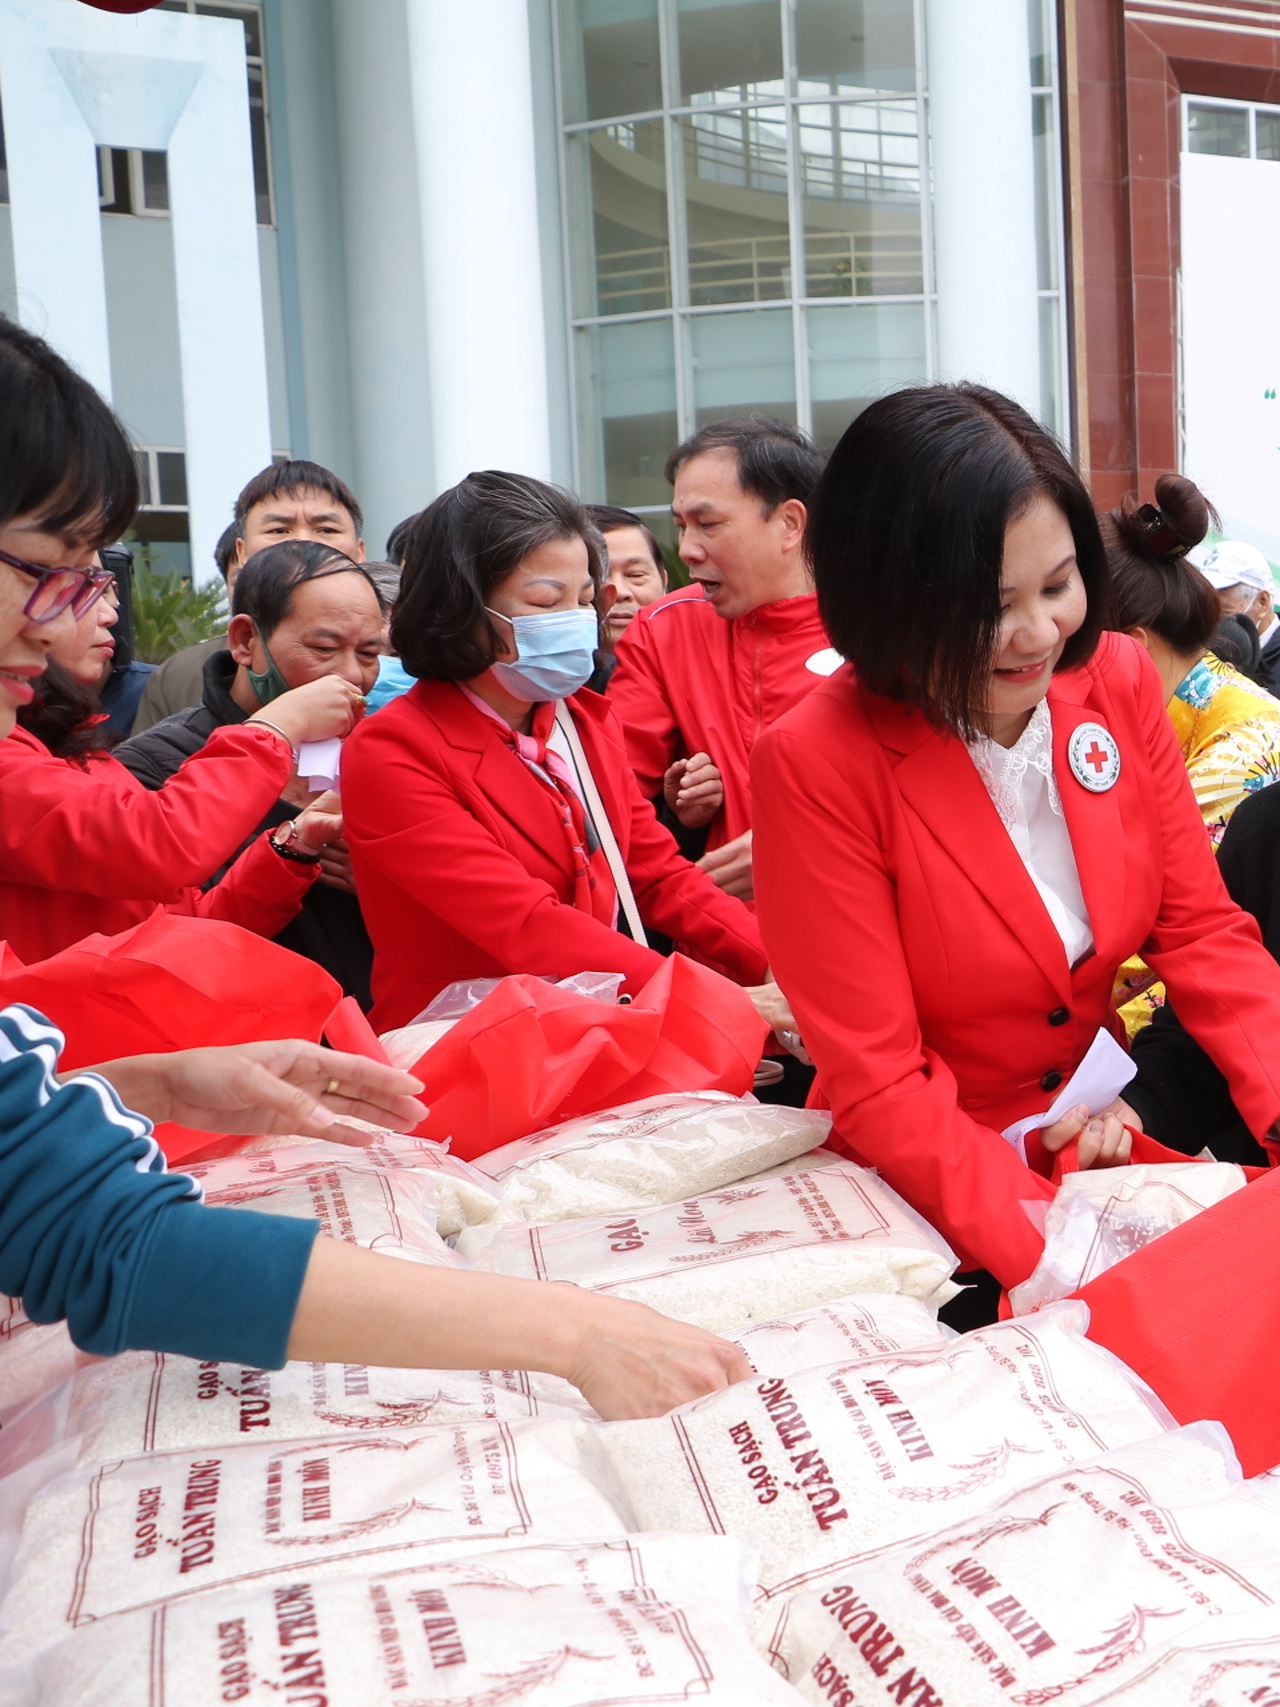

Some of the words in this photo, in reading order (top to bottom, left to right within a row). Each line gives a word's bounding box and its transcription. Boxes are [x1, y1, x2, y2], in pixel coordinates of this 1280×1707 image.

[197, 1371, 224, 1400] GẠO
[344, 1365, 370, 1396] KIN
[862, 1379, 904, 1407] MÔN
[1028, 1363, 1046, 1389] 888
[225, 1370, 271, 1432] TUẤN
[757, 1378, 812, 1450] TRUNG
[728, 1420, 763, 1465] SẠCH
[885, 1409, 935, 1462] KINH
[183, 1459, 223, 1511] TRUNG
[295, 1457, 330, 1482] MÔN
[747, 1464, 779, 1505] GẠO
[783, 1449, 848, 1531] TUẤN
[136, 1485, 166, 1522] SẠCH
[302, 1485, 331, 1522] KINH
[1119, 1490, 1146, 1507] 102
[134, 1523, 163, 1559] GẠO
[165, 1510, 216, 1574] TUẤN
[1139, 1509, 1167, 1535] 888
[946, 1557, 1002, 1598] MÔN
[273, 1584, 319, 1647] TRUNG
[821, 1585, 905, 1677] TRUNG
[986, 1594, 1057, 1659] KINH
[218, 1617, 253, 1660] SẠCH
[423, 1617, 467, 1669] KINH
[222, 1661, 256, 1701] GẠO
[262, 1648, 328, 1707] UẤN
[989, 1662, 1016, 1688] ĐẶC
